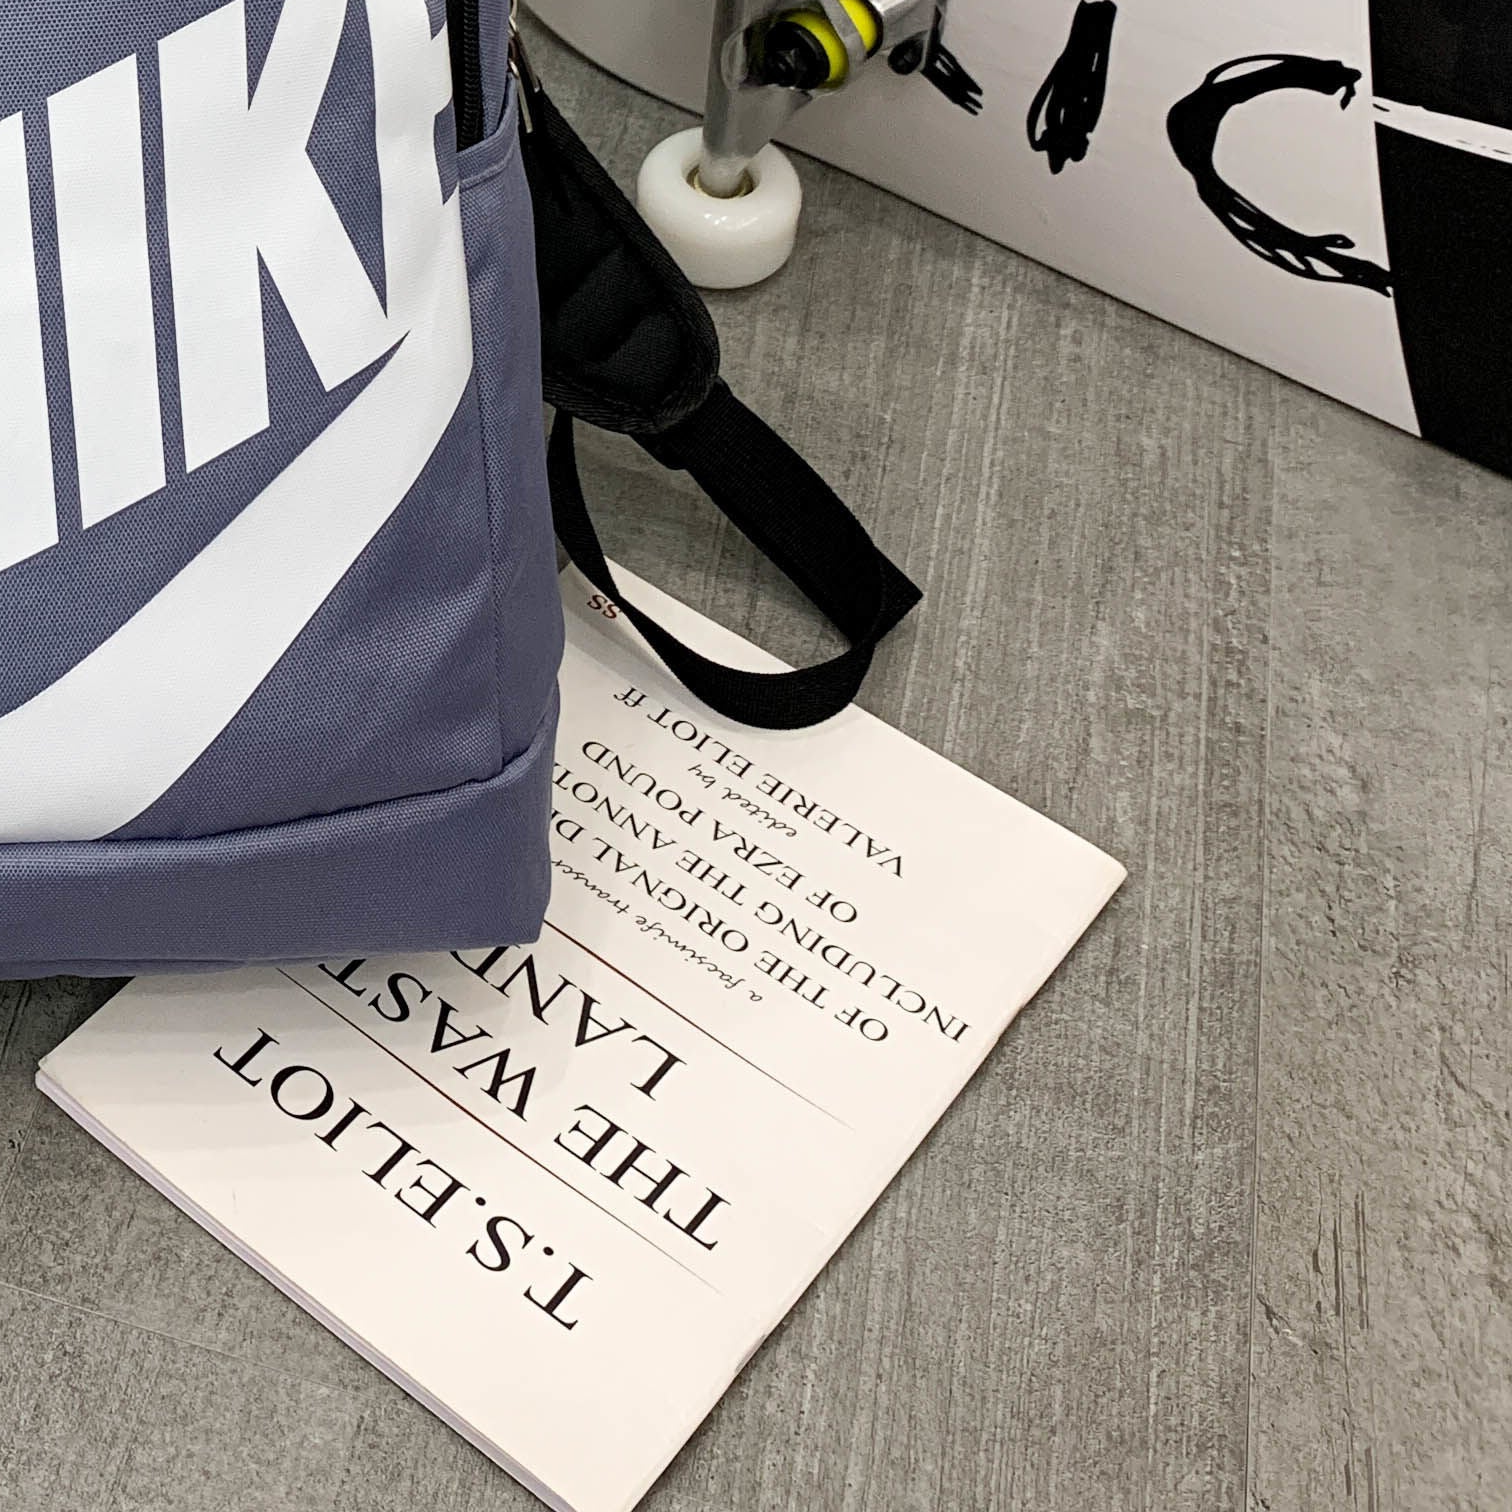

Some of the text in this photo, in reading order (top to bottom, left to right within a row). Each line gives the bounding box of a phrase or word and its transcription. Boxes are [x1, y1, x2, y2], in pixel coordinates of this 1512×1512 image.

[647, 707, 756, 779] ELIOT
[581, 740, 859, 925] OF EZRA POUND
[687, 763, 798, 839] edited by
[755, 772, 905, 879] VALERIE
[551, 859, 631, 915] transcr
[552, 762, 972, 1044] INCLUDING THE ANNOT
[592, 835, 750, 954] ORIGNAL
[748, 989, 764, 1002] a
[753, 949, 830, 1010] THE
[834, 1005, 889, 1044] OF
[317, 957, 732, 1252] THE WAST
[213, 1027, 594, 1331] T.S.ELIOT
